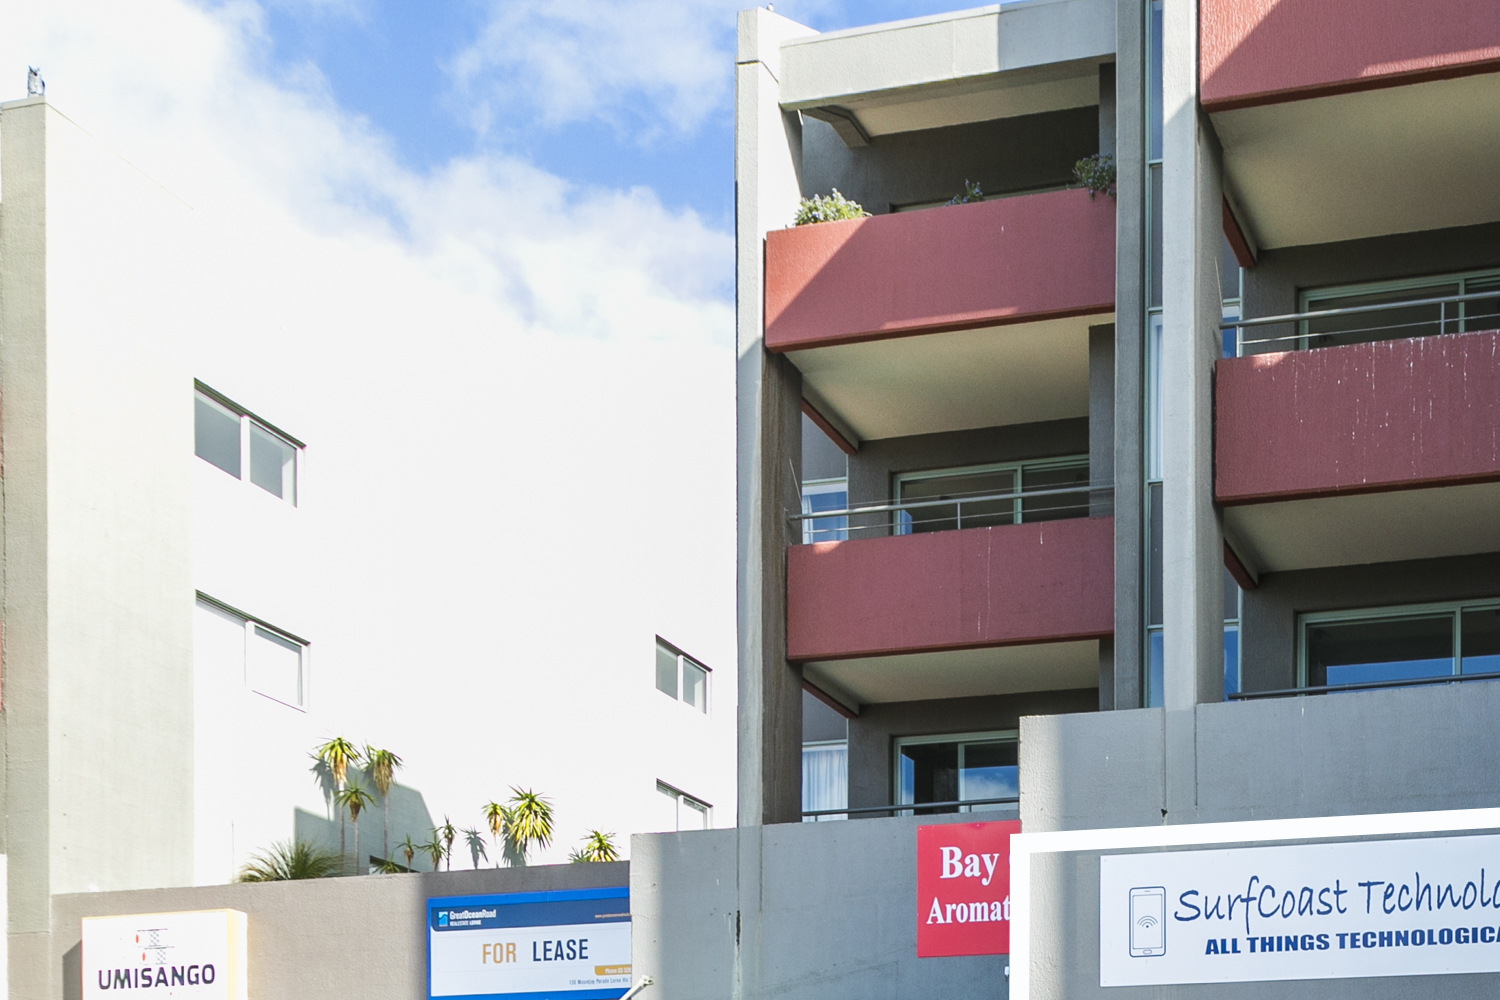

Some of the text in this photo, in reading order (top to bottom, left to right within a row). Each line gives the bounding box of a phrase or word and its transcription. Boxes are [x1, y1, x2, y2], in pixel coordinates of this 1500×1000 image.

[940, 846, 1000, 886] Bay
[926, 895, 1010, 925] Aromat
[1174, 875, 1348, 935] SurfCoast
[482, 938, 589, 964] FOR LEASE
[1204, 937, 1241, 956] ALL
[1246, 933, 1330, 954] THINGS
[98, 963, 216, 990] UMISANGO
